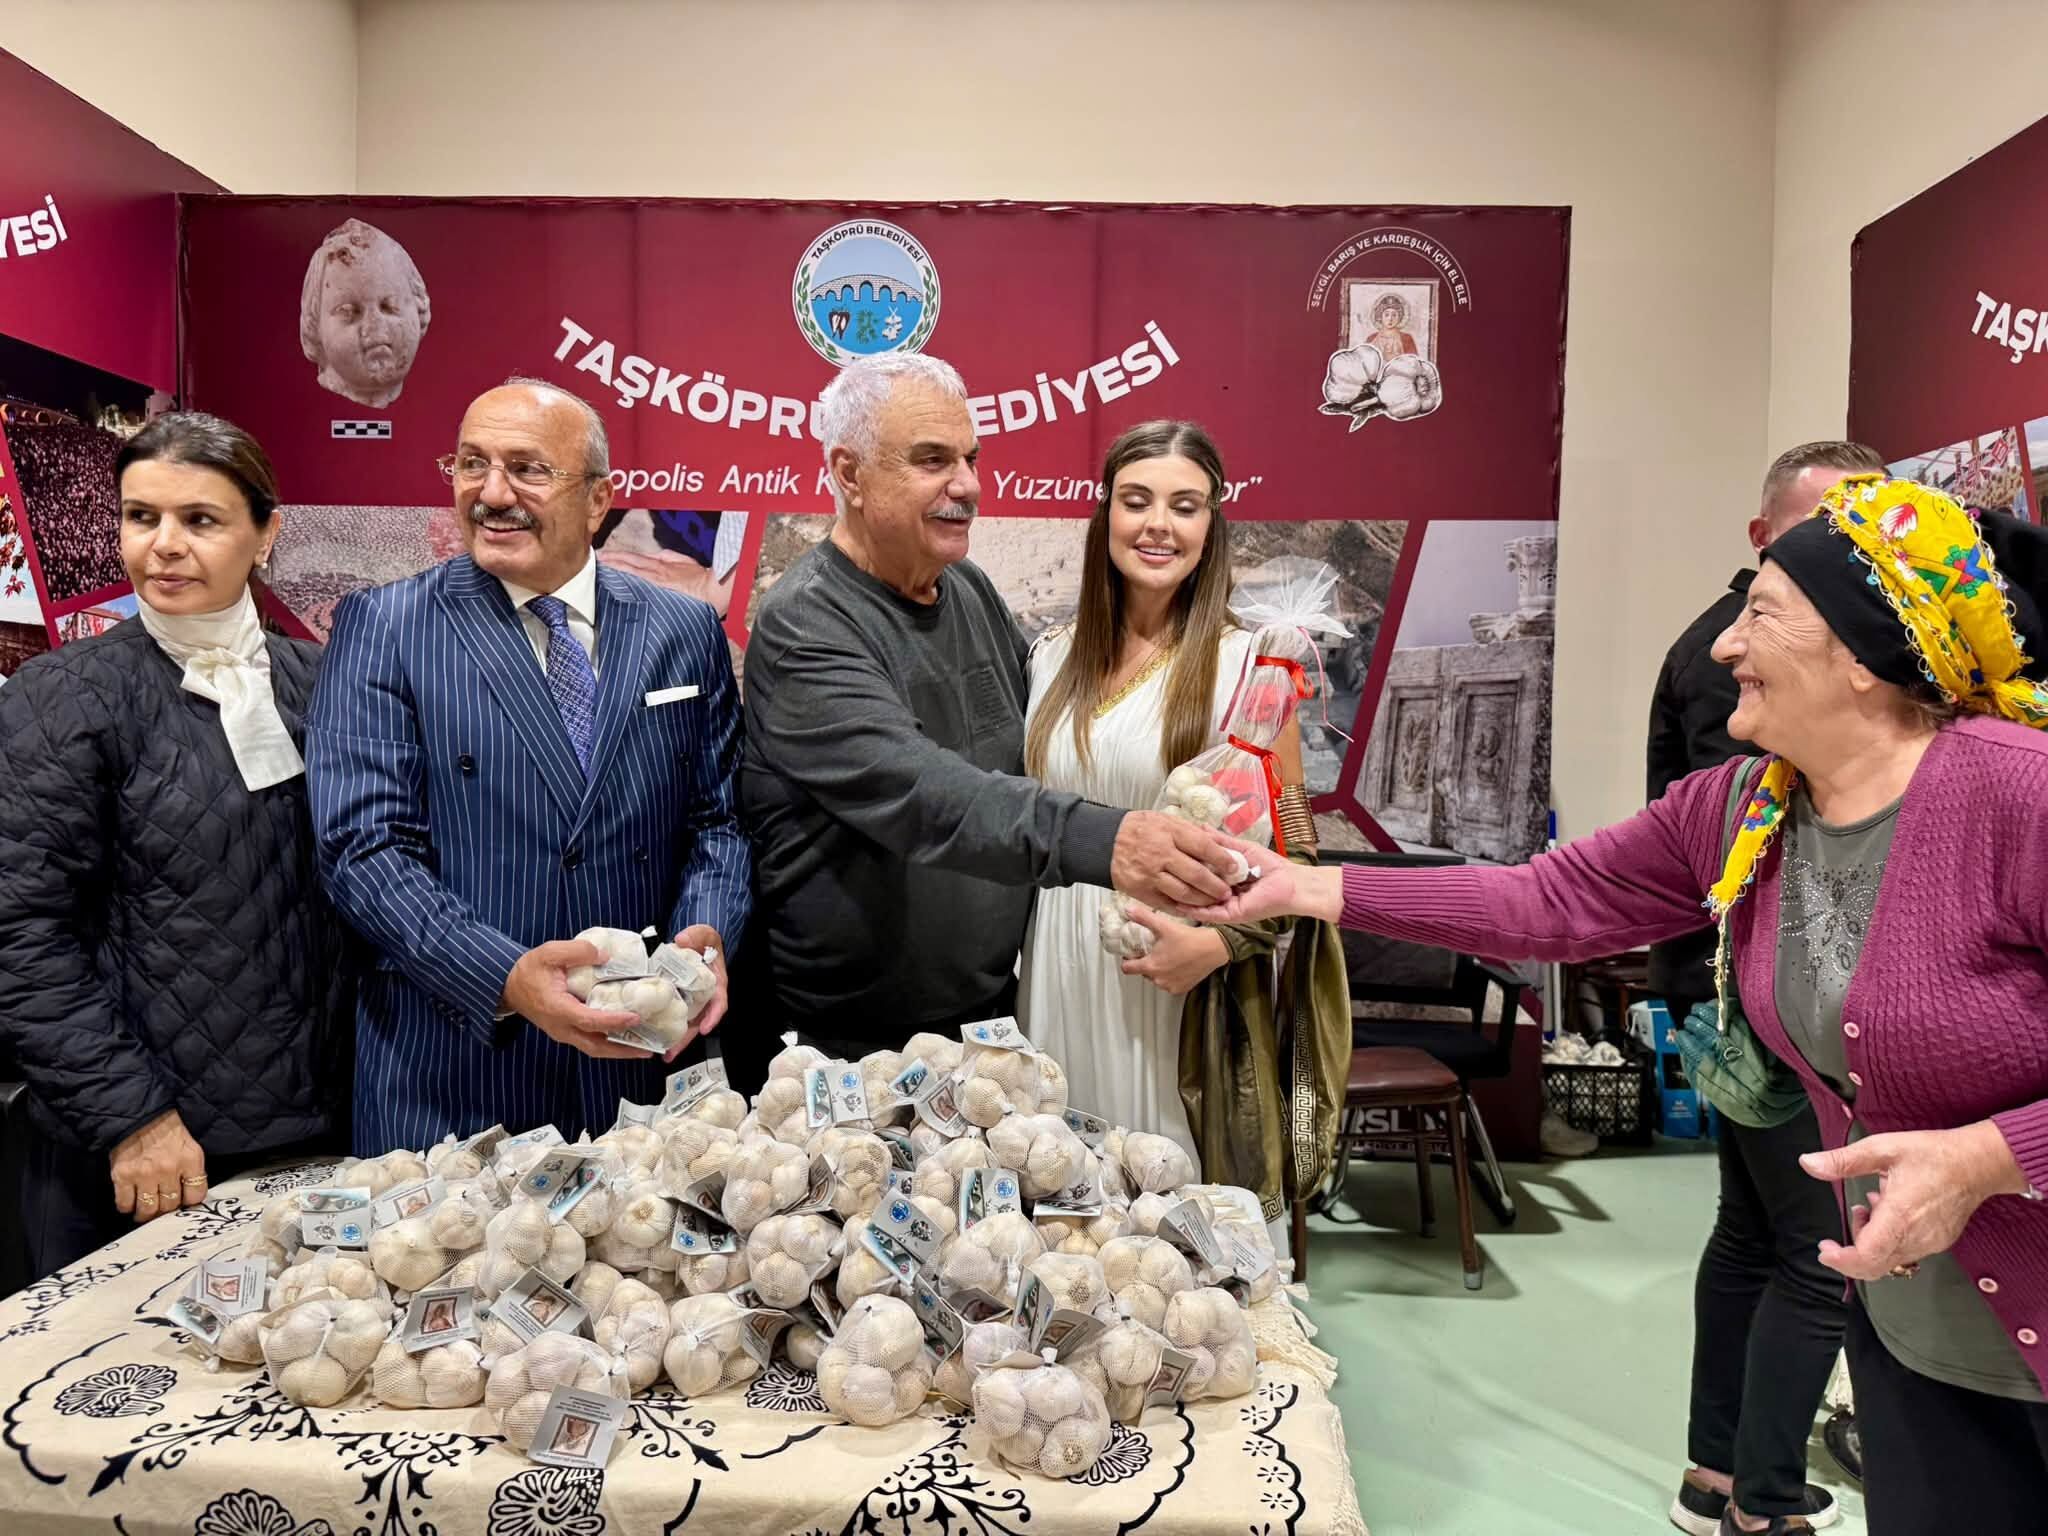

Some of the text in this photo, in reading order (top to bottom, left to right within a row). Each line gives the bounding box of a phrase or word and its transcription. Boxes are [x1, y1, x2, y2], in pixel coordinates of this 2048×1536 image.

[0, 194, 68, 258] YESİ
[811, 224, 924, 262] TAŞKÖPRÜ BELEDİYESİ
[1328, 246, 1356, 273] BARIŞ
[1356, 238, 1373, 250] VE
[1373, 234, 1433, 255] KARDEŞLİK
[1432, 249, 1452, 271] İÇİN
[1448, 269, 1460, 284] EL
[1455, 284, 1468, 305] ELE
[1971, 291, 2048, 364] TAŞK
[966, 319, 1180, 437] EDİYESİ
[609, 463, 704, 498] opolis
[719, 464, 801, 495] Antik
